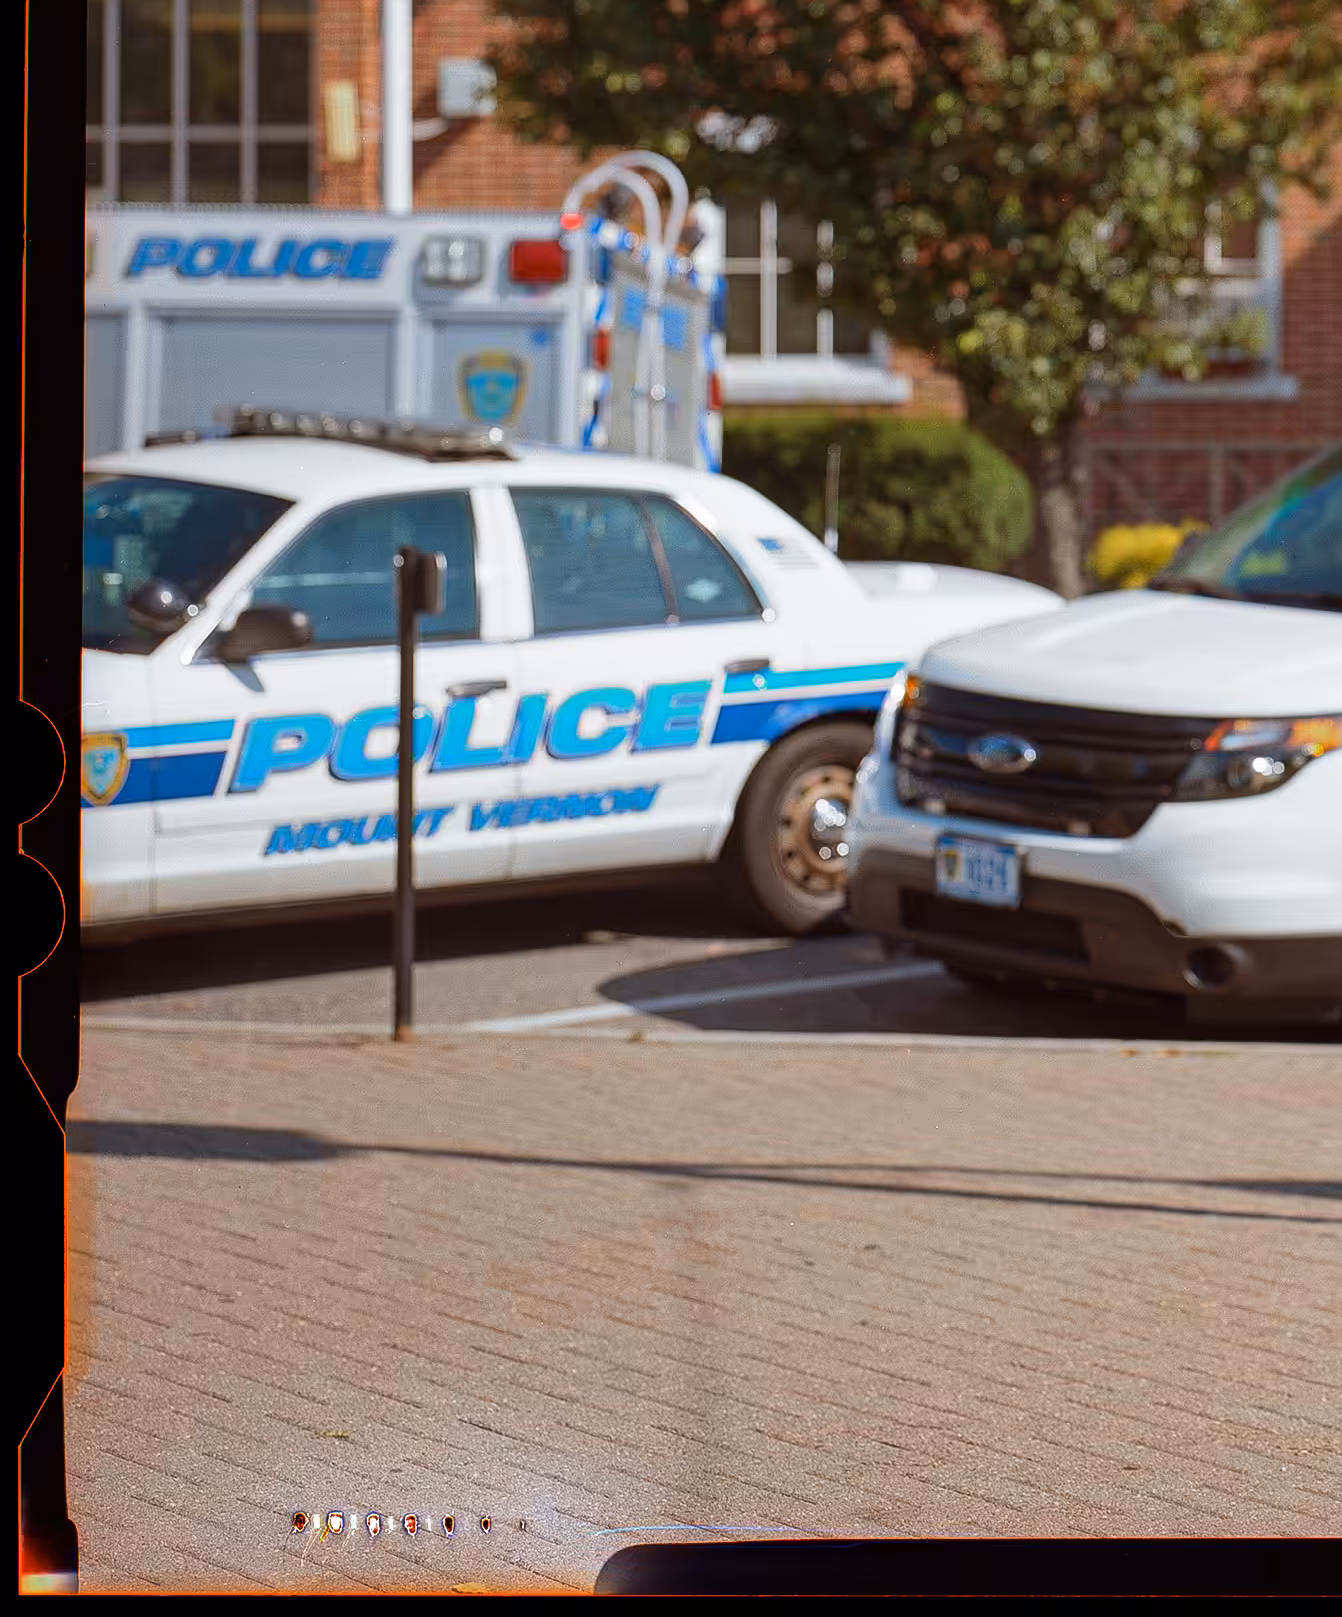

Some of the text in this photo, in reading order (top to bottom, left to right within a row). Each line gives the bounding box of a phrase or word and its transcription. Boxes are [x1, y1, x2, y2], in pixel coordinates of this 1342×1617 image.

[125, 237, 393, 280] POLICE
[227, 679, 713, 794] POLICE
[468, 784, 661, 832] VERNON
